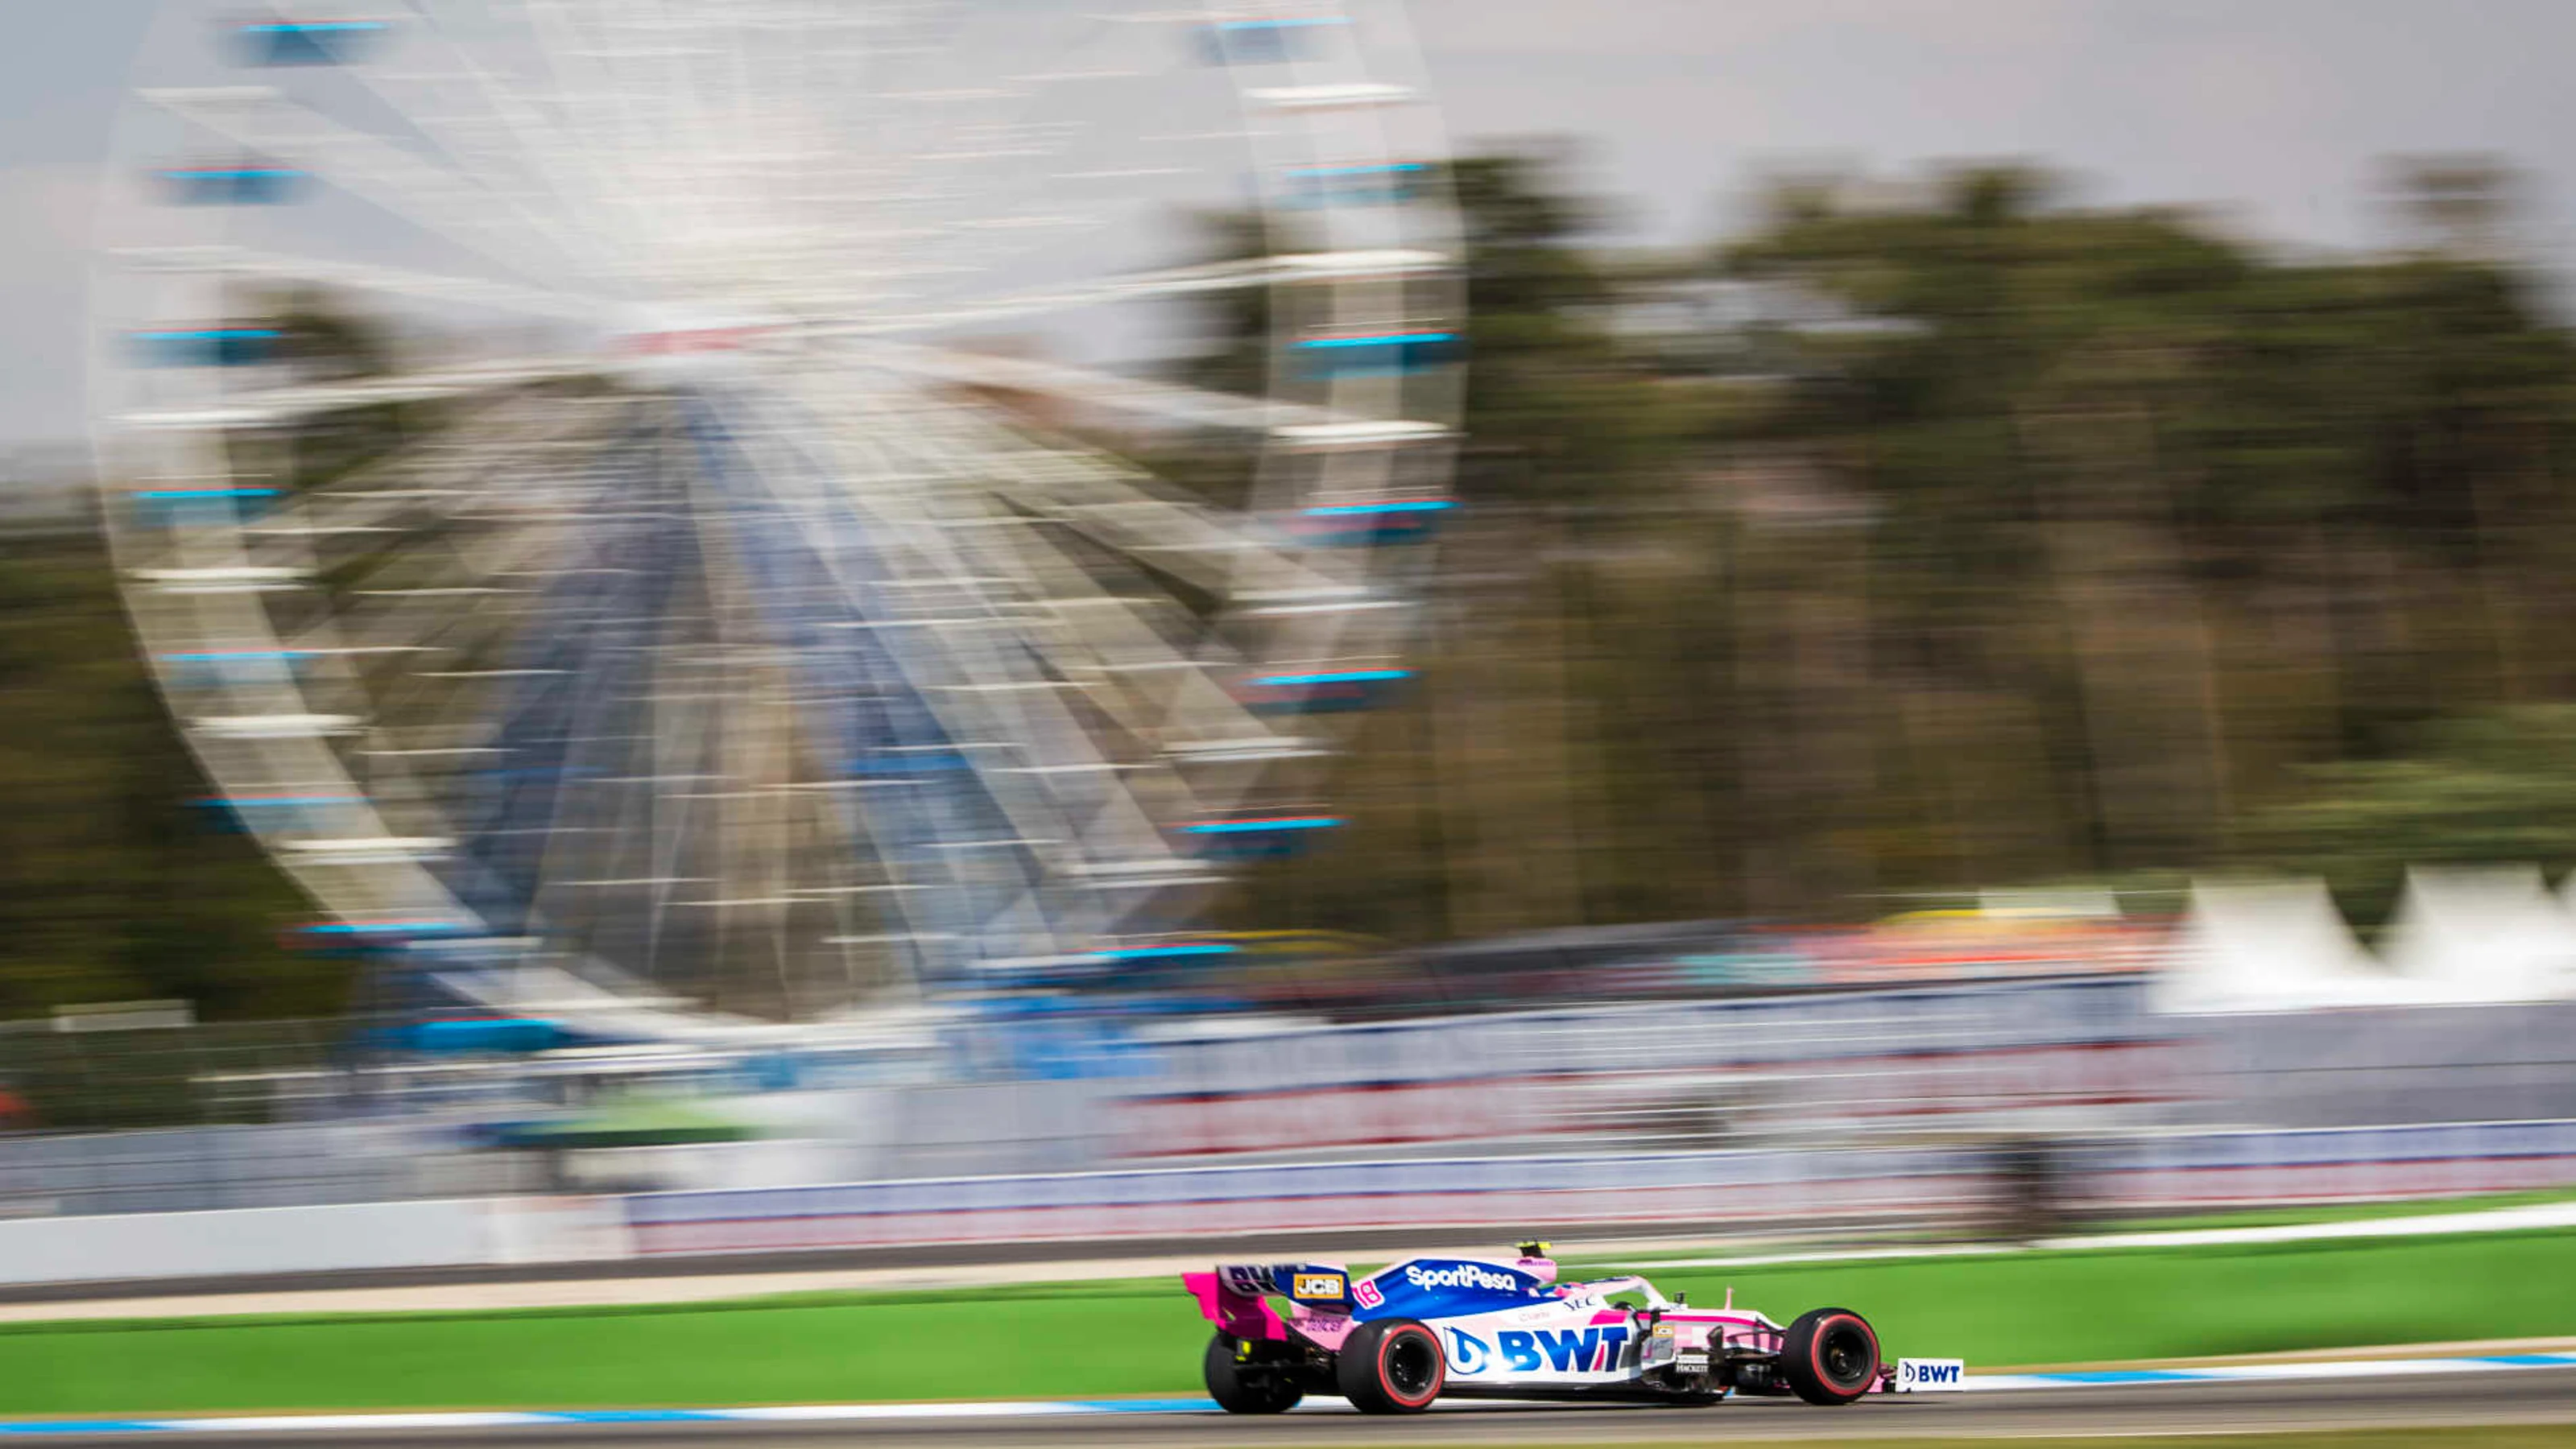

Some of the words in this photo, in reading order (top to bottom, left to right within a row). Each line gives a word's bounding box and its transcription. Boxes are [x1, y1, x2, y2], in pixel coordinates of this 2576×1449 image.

[1297, 1279, 1339, 1294] JCB
[1405, 1265, 1517, 1291] SportPesa
[1352, 1280, 1383, 1307] 18
[1497, 1327, 1628, 1373] BWT
[1919, 1365, 1960, 1383] BWT
